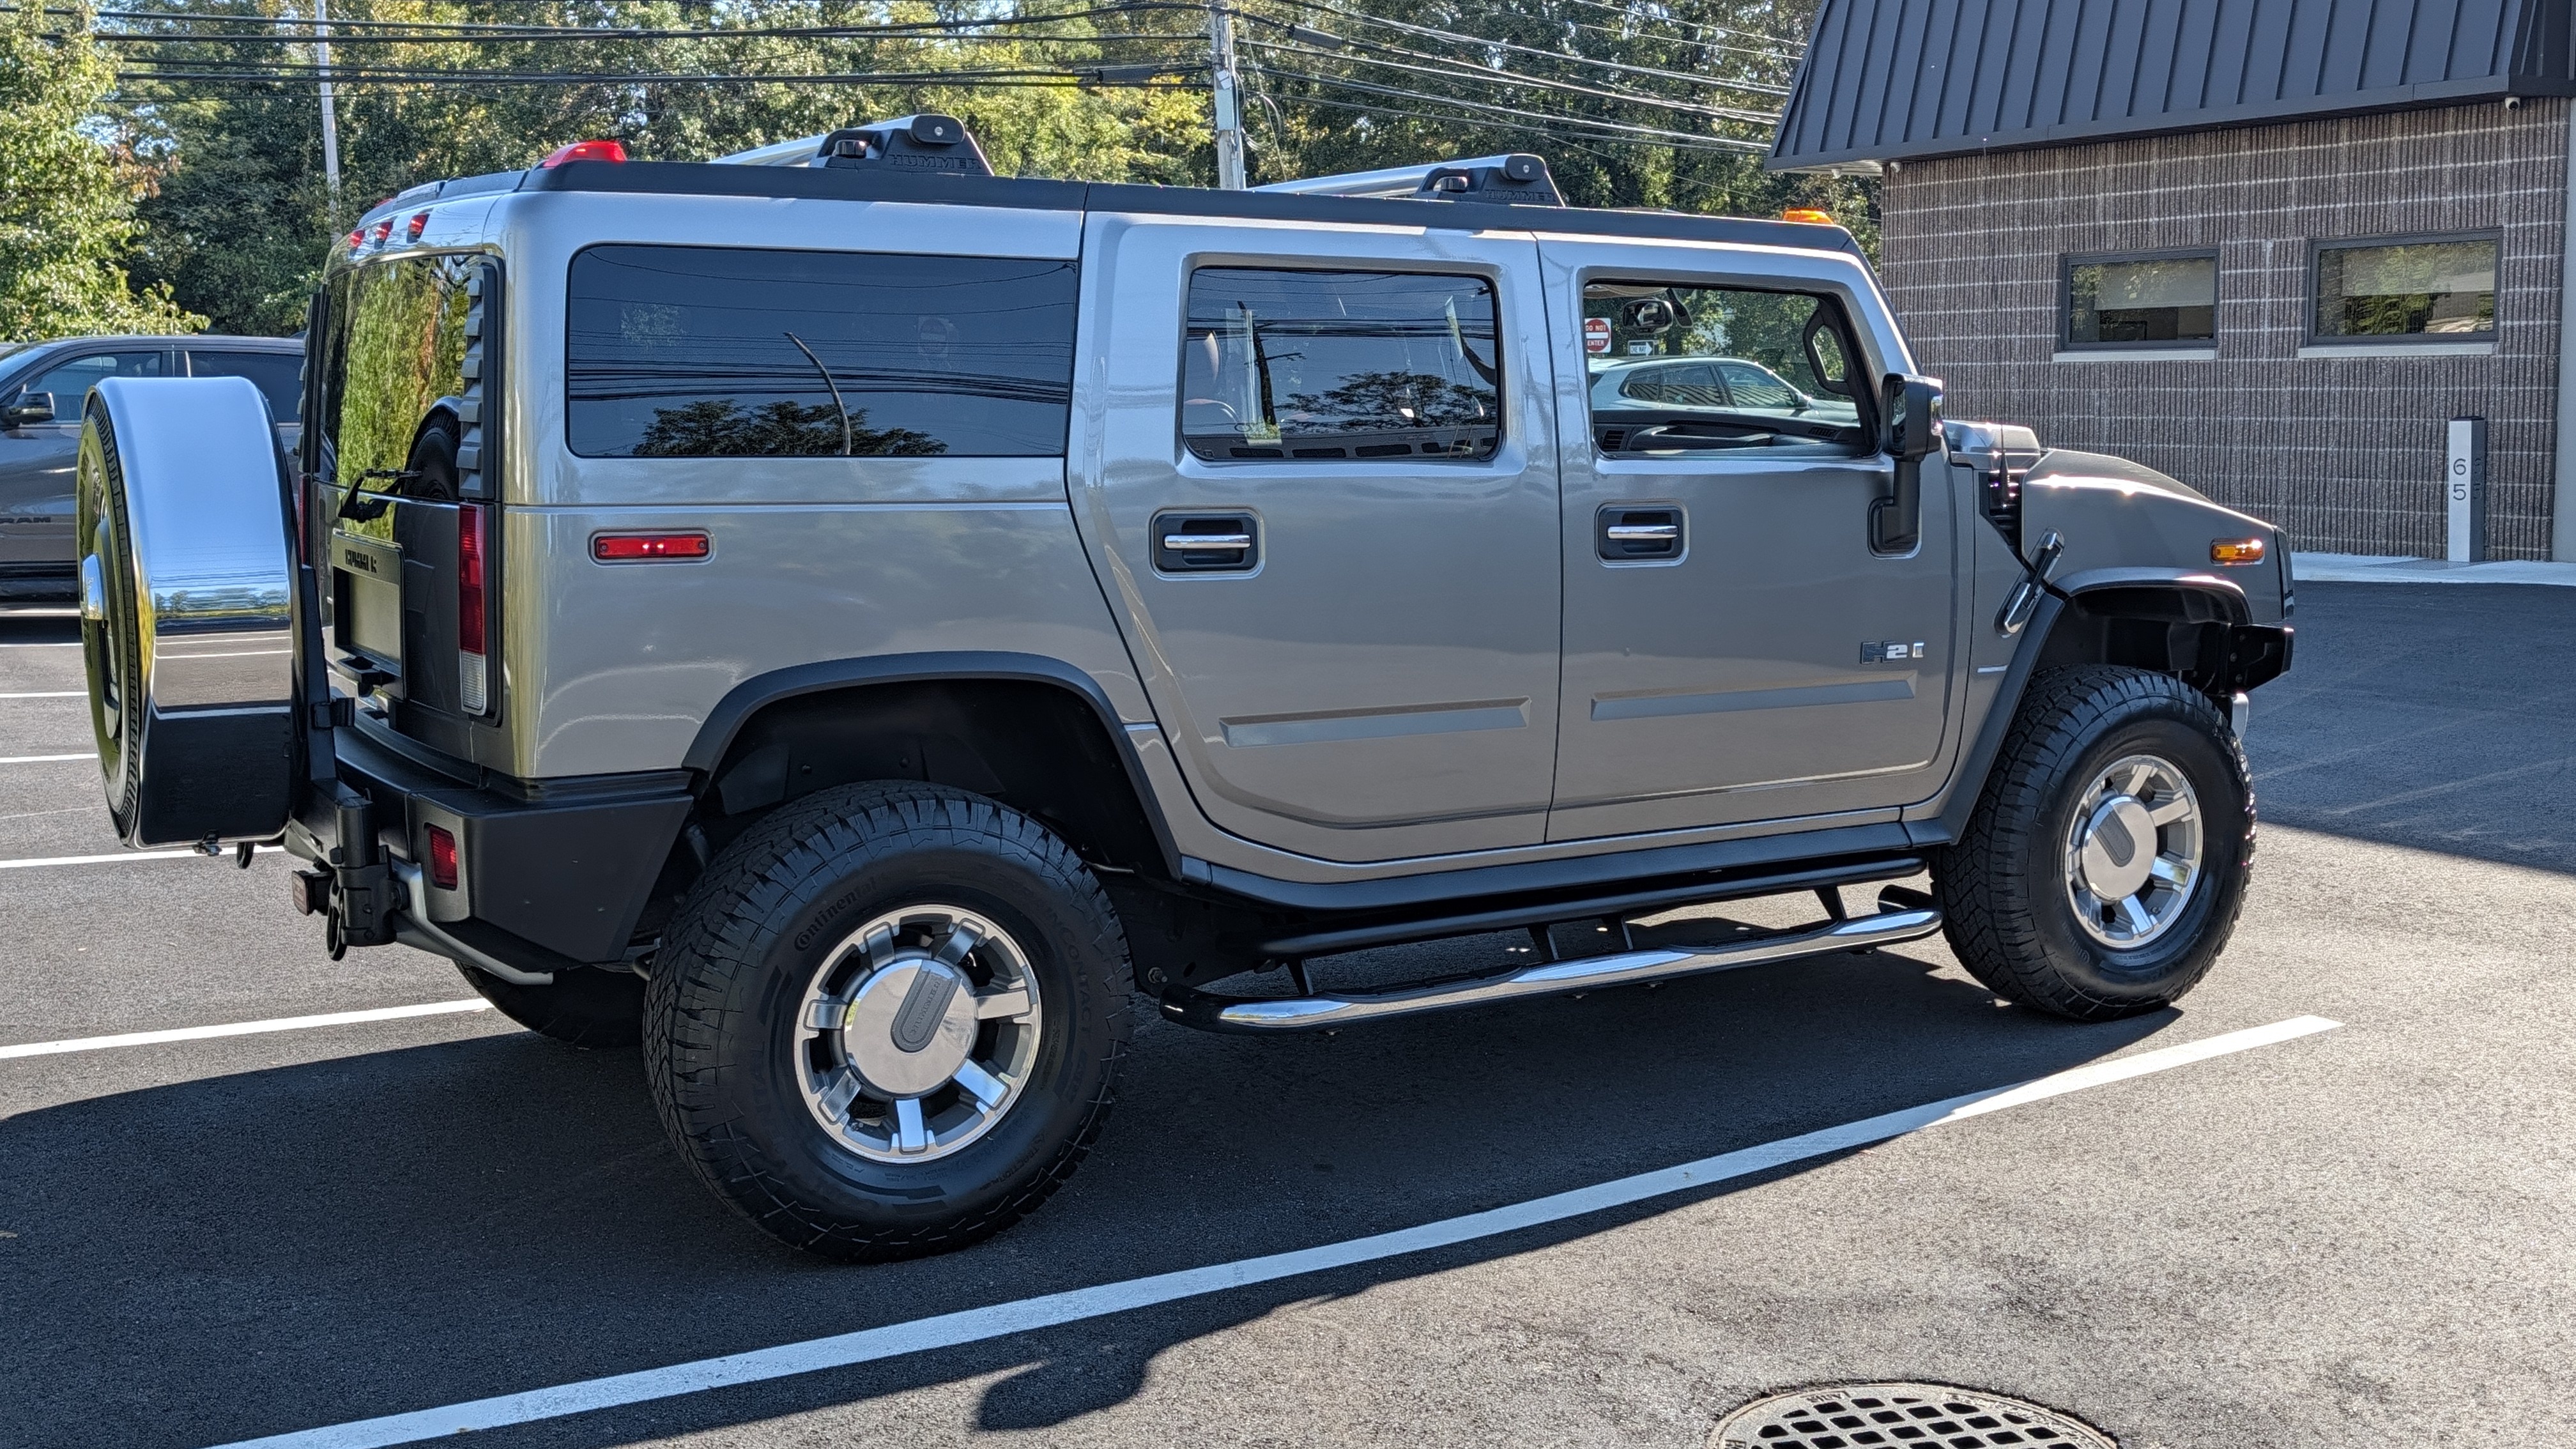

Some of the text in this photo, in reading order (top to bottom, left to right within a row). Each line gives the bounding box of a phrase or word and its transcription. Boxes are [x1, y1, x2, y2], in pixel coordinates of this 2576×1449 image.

[889, 154, 981, 169] HUMMER
[1485, 189, 1556, 202] HUMMER
[1860, 640, 1908, 664] H2
[794, 876, 877, 952] Continental
